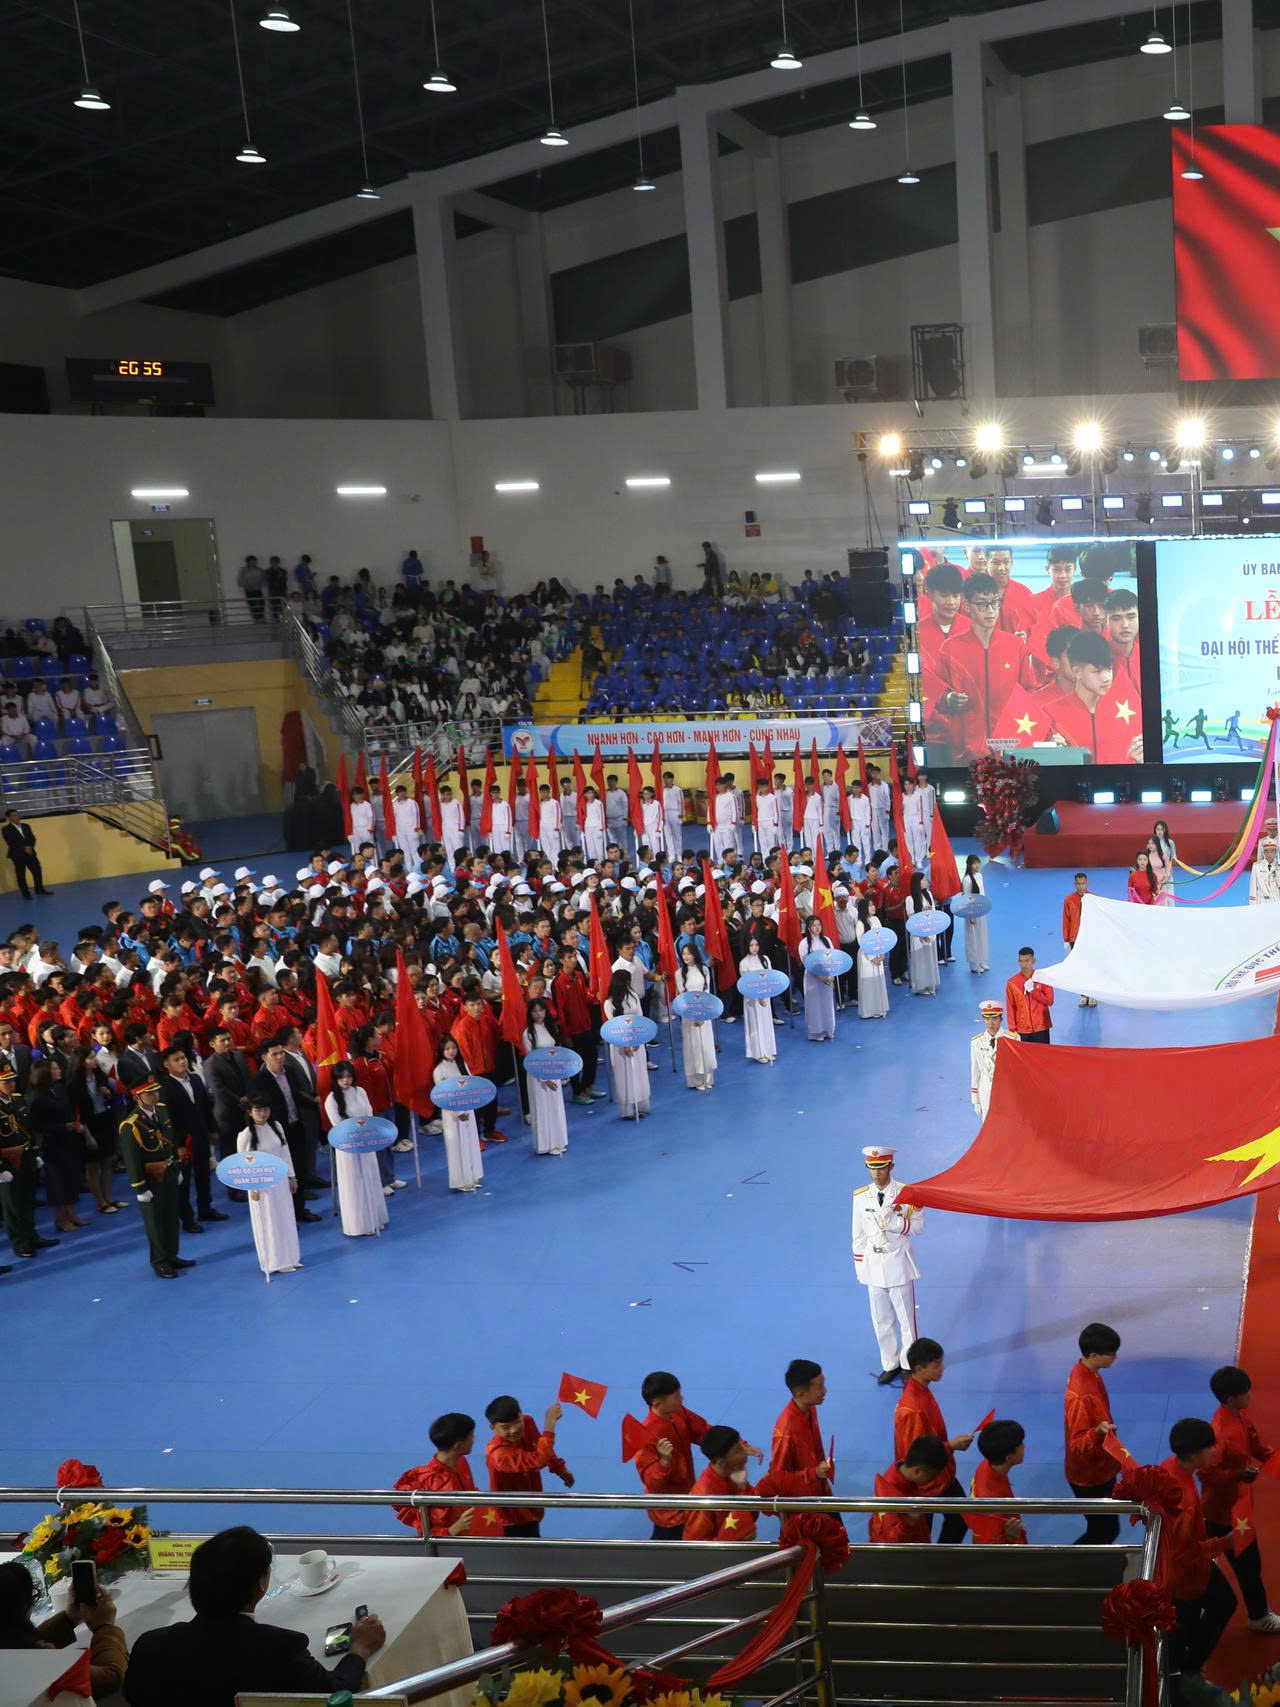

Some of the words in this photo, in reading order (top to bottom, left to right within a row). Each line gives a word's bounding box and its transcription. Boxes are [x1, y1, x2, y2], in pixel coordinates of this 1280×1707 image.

[1201, 639, 1223, 659] ĐẠI
[1228, 637, 1250, 659] HỘI
[1255, 632, 1280, 654] THỂ
[587, 732, 618, 745] NHANH
[620, 731, 639, 745] HƠN
[647, 731, 665, 744] CAO
[667, 730, 685, 744] HƠN
[722, 728, 741, 742] HƠN
[776, 727, 801, 741] NHAU
